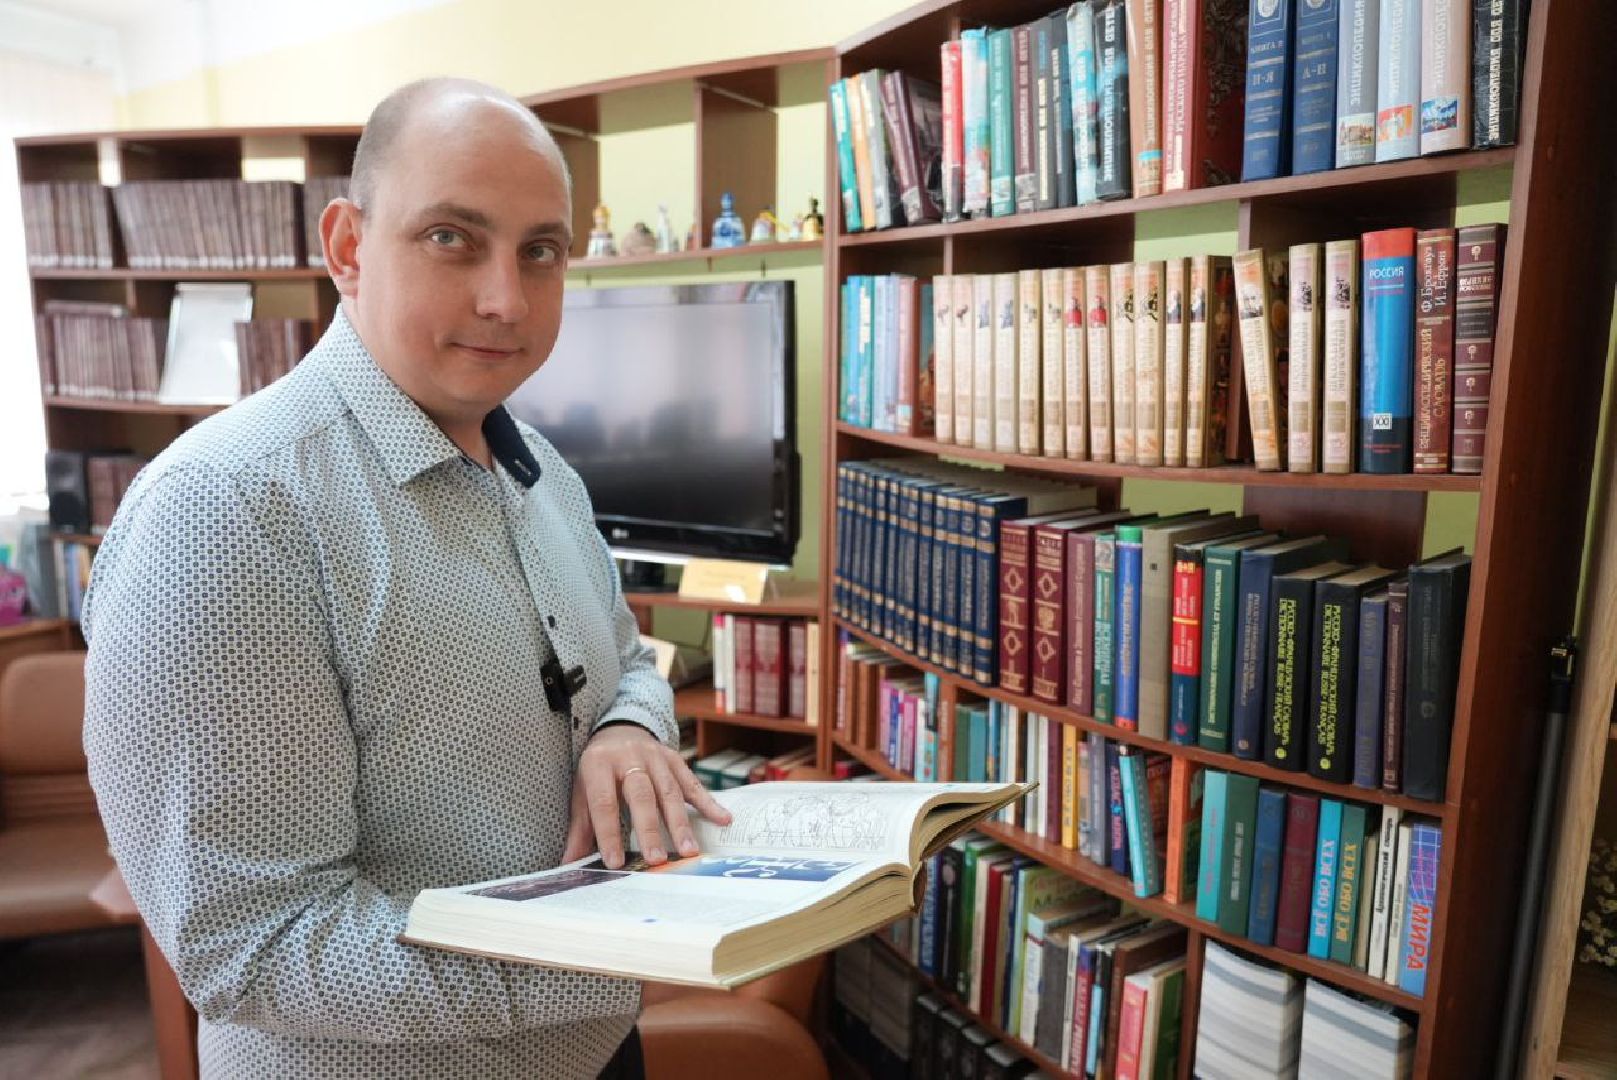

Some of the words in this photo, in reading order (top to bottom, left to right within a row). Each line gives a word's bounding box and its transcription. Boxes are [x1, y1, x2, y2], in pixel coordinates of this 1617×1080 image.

[1369, 265, 1404, 280] РОССИЯ
[1421, 246, 1436, 298] Брокгауз
[1434, 250, 1449, 290] Ефрон
[1419, 328, 1433, 449] ЭНЦИКЛОПЕДИЧЕСКИЙ
[1432, 358, 1446, 418] СЛОВАРЬ
[1277, 598, 1288, 659] DICTIONNAIRE
[1321, 605, 1333, 668] DICTIONNAIRE
[1320, 840, 1335, 877] ВСЕХ
[1343, 842, 1357, 880] ВСЕХ
[1318, 878, 1331, 909] ОБО
[1340, 883, 1353, 913] ОБО
[1407, 902, 1432, 970] МИРА
